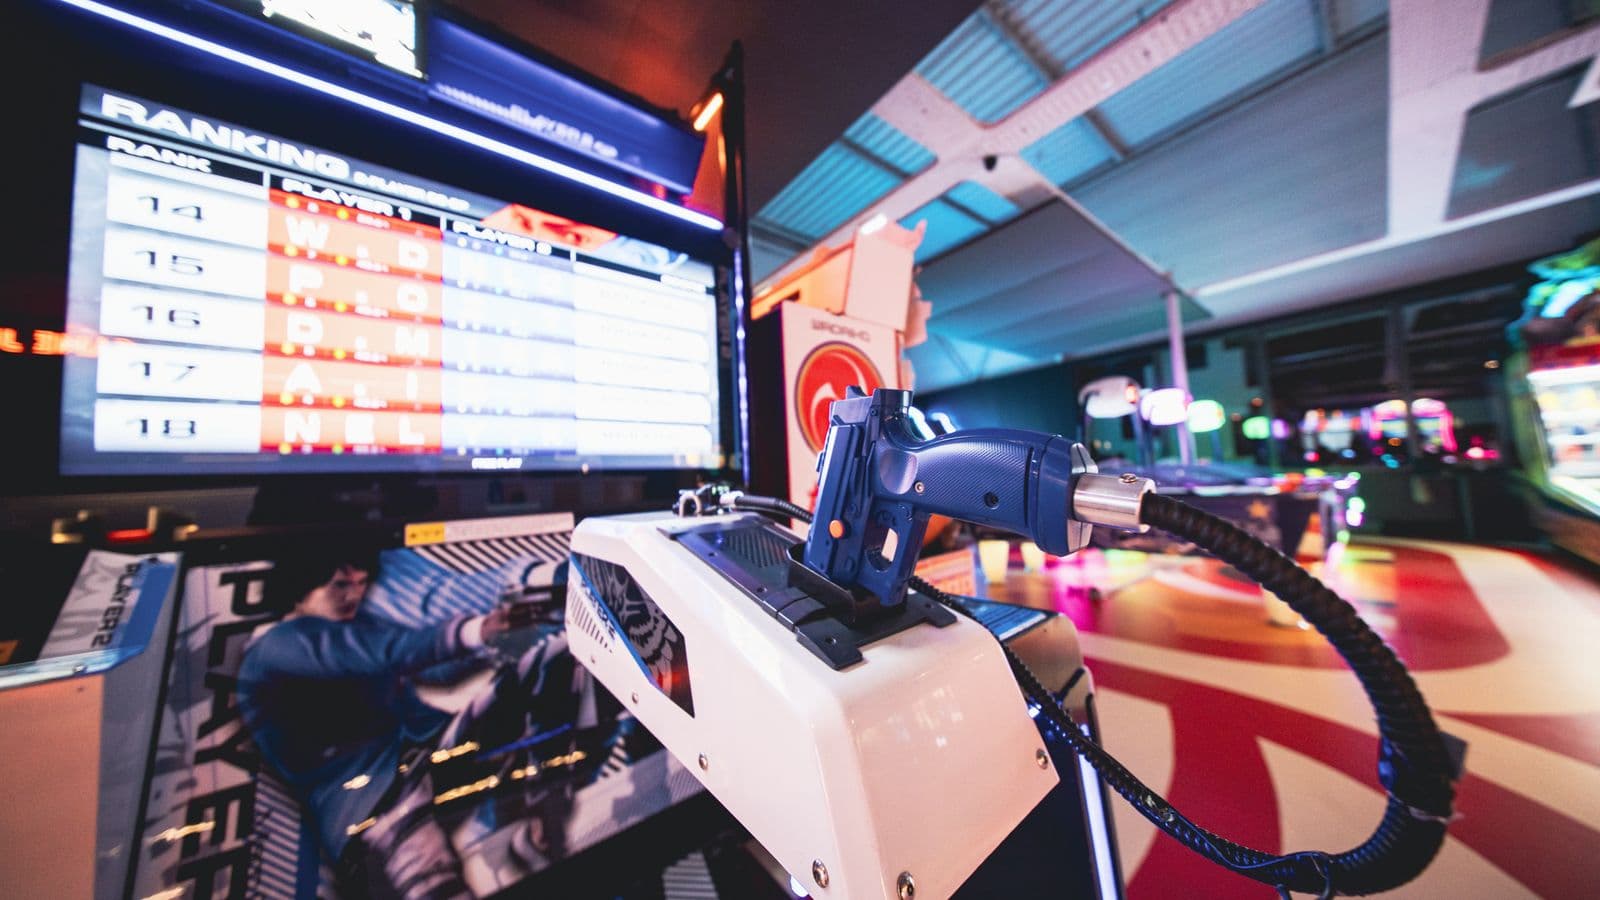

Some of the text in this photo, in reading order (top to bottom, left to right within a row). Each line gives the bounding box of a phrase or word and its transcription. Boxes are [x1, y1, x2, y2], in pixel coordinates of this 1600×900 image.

[101, 93, 350, 179] RANKING
[106, 135, 213, 173] RANK
[136, 194, 204, 222] 14
[281, 177, 394, 217] PLAYER
[397, 206, 411, 222] 1
[286, 214, 330, 250] W
[136, 250, 204, 275] 15
[289, 265, 324, 293] P
[131, 304, 201, 328] 16
[131, 360, 197, 382] 17
[283, 362, 322, 395] A
[127, 416, 198, 439] 18
[283, 411, 321, 443] N
[399, 415, 425, 446] L
